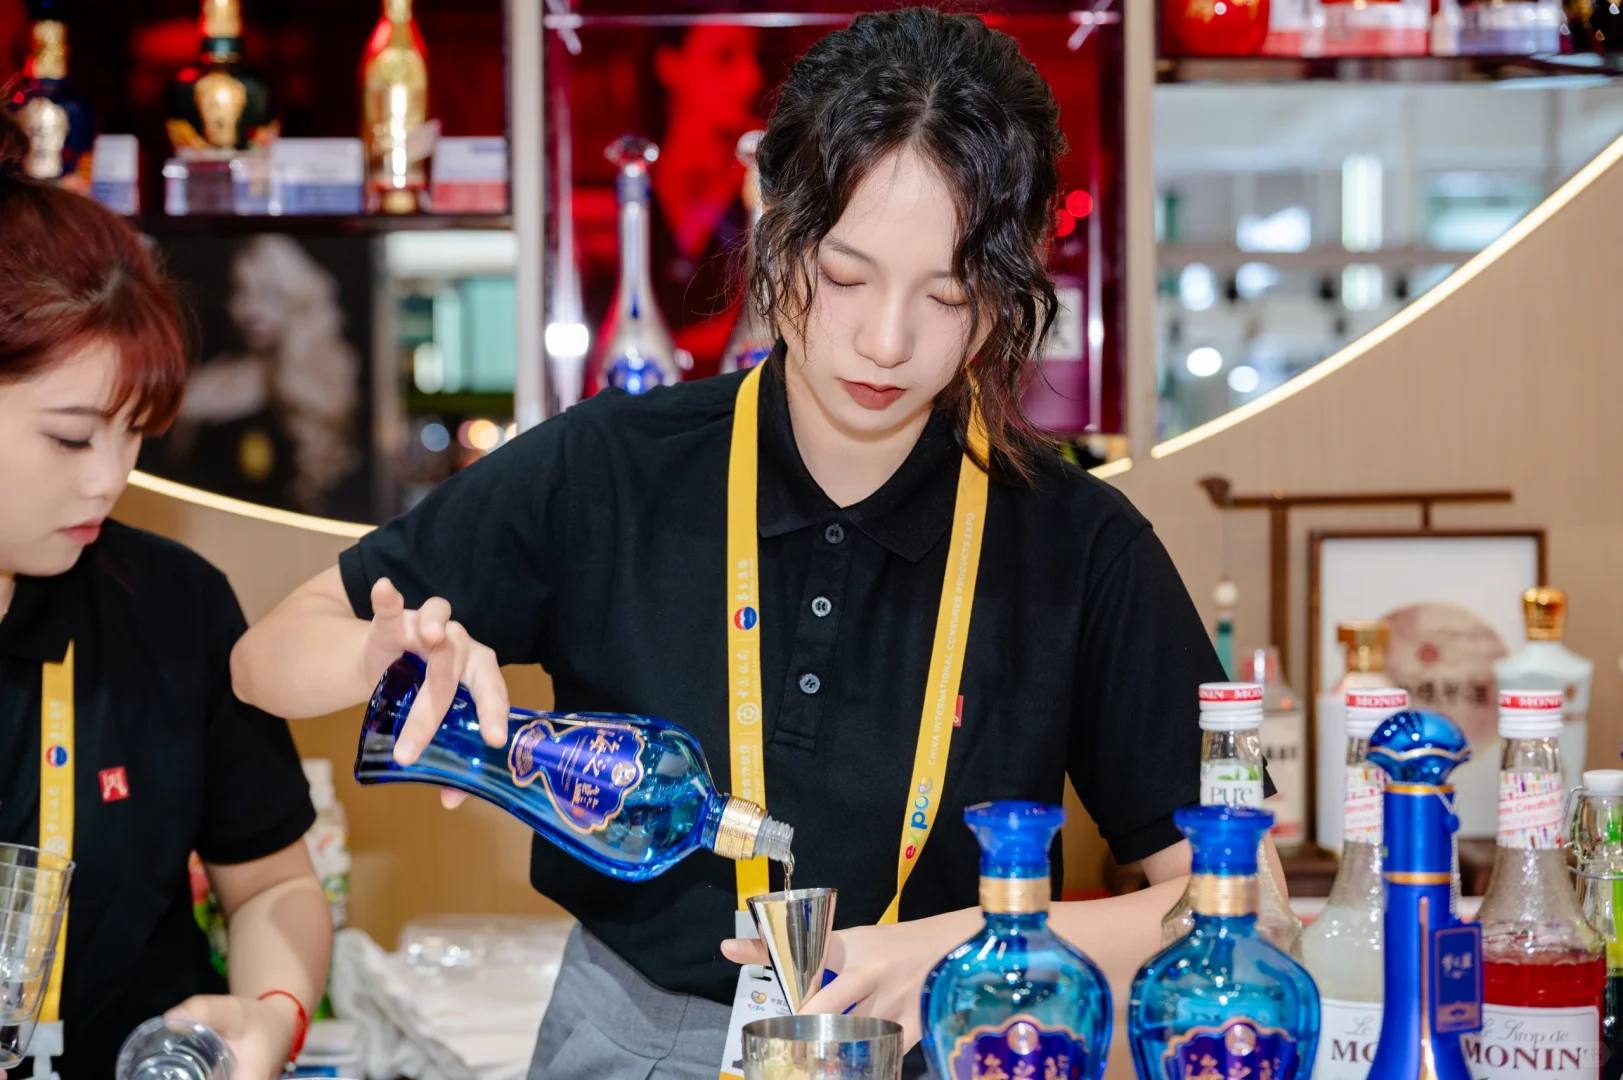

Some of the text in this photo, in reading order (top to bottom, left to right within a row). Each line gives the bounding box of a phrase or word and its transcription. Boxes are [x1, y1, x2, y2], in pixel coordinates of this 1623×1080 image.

[928, 512, 976, 767] CHINA INTERNATIONAL CONSUMER PRODUCTS EXPO
[1498, 1019, 1545, 1047] Sirop
[1550, 1028, 1569, 1043] de
[1465, 1040, 1582, 1071] MONIN
